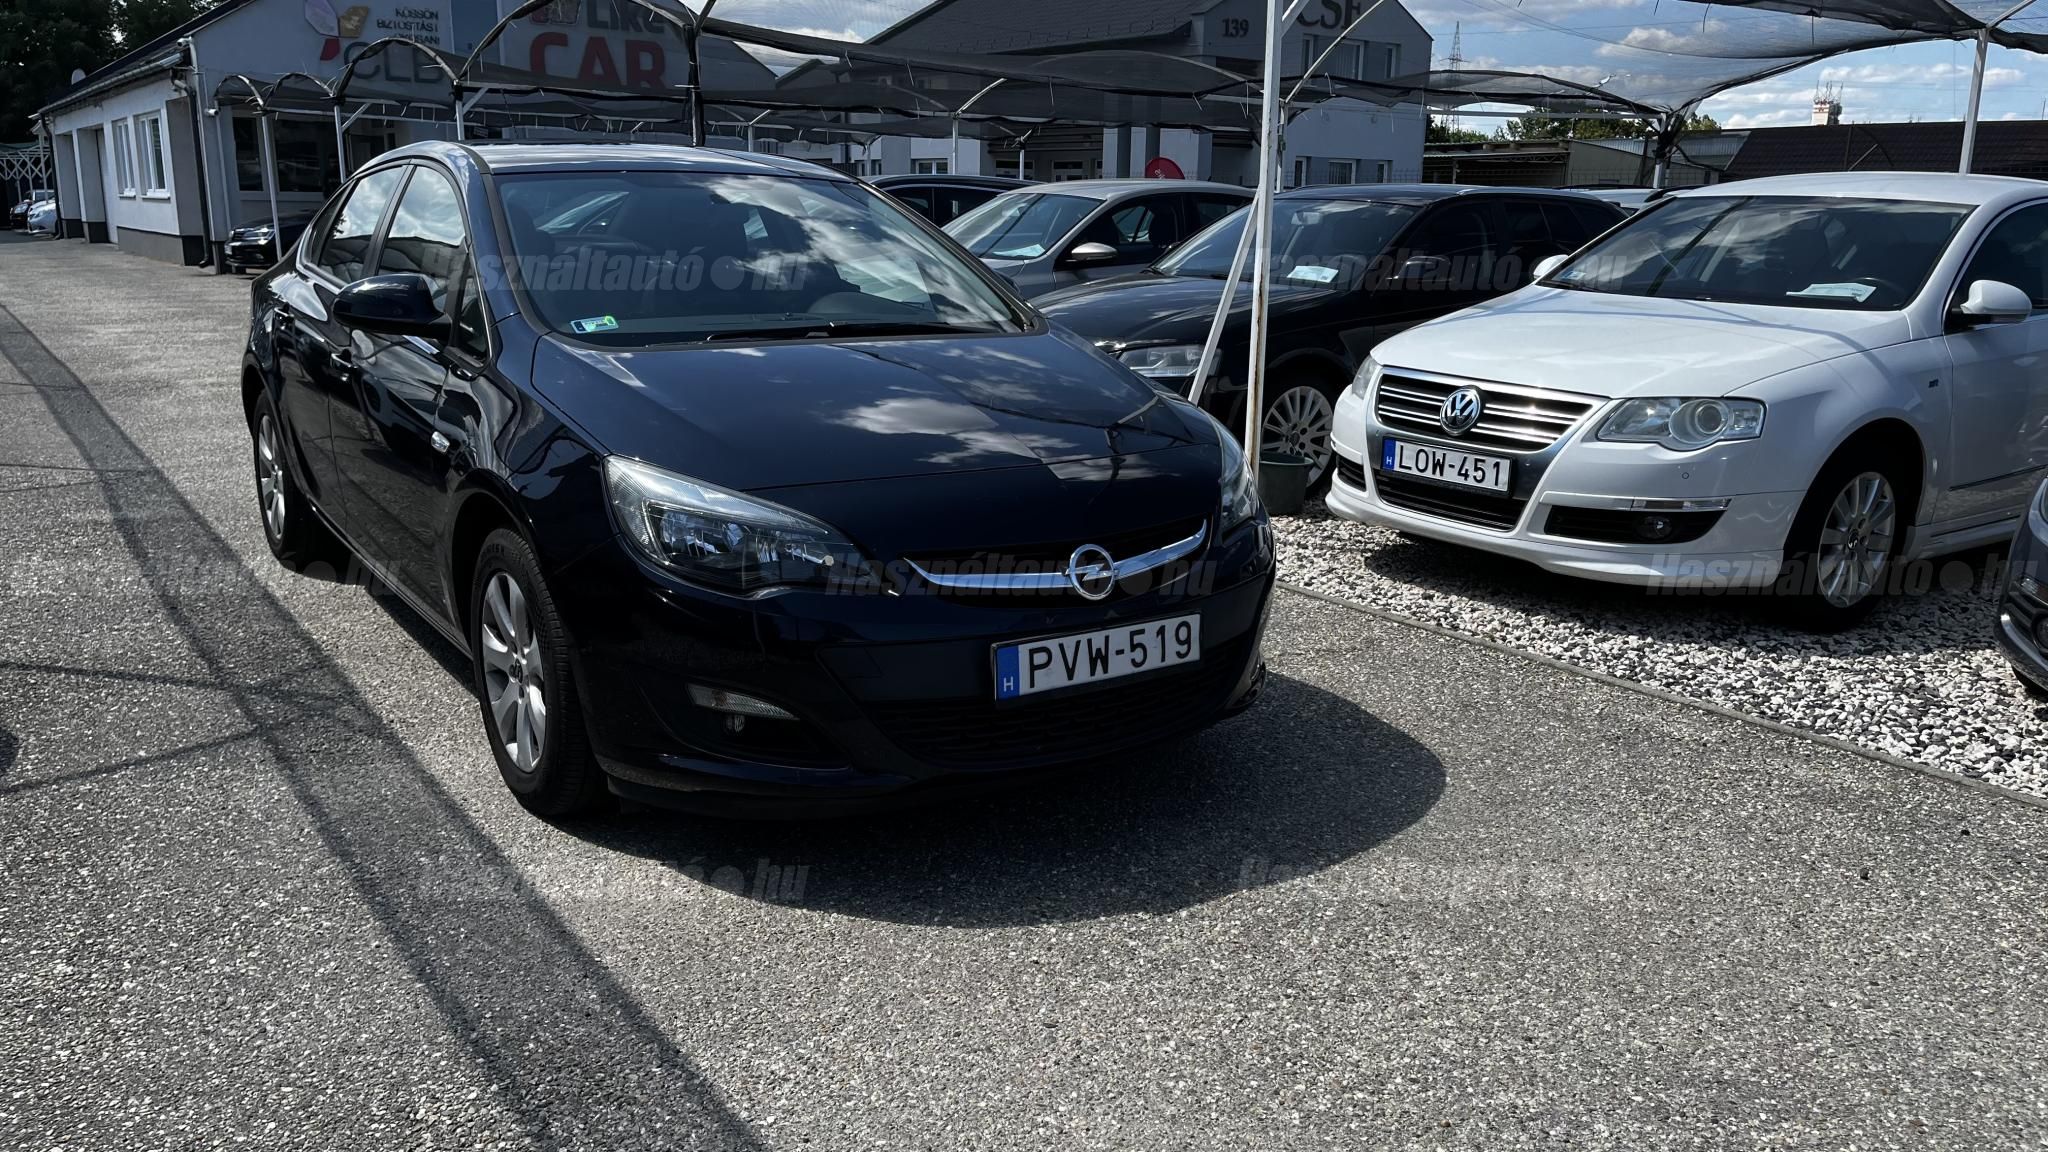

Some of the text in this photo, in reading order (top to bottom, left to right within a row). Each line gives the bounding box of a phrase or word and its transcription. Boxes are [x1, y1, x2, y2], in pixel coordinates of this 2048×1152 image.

[1222, 17, 1249, 38] 139
[529, 32, 666, 95] CAR
[1385, 444, 1501, 487] H LOW-451
[1003, 620, 1192, 692] H PVW-519
